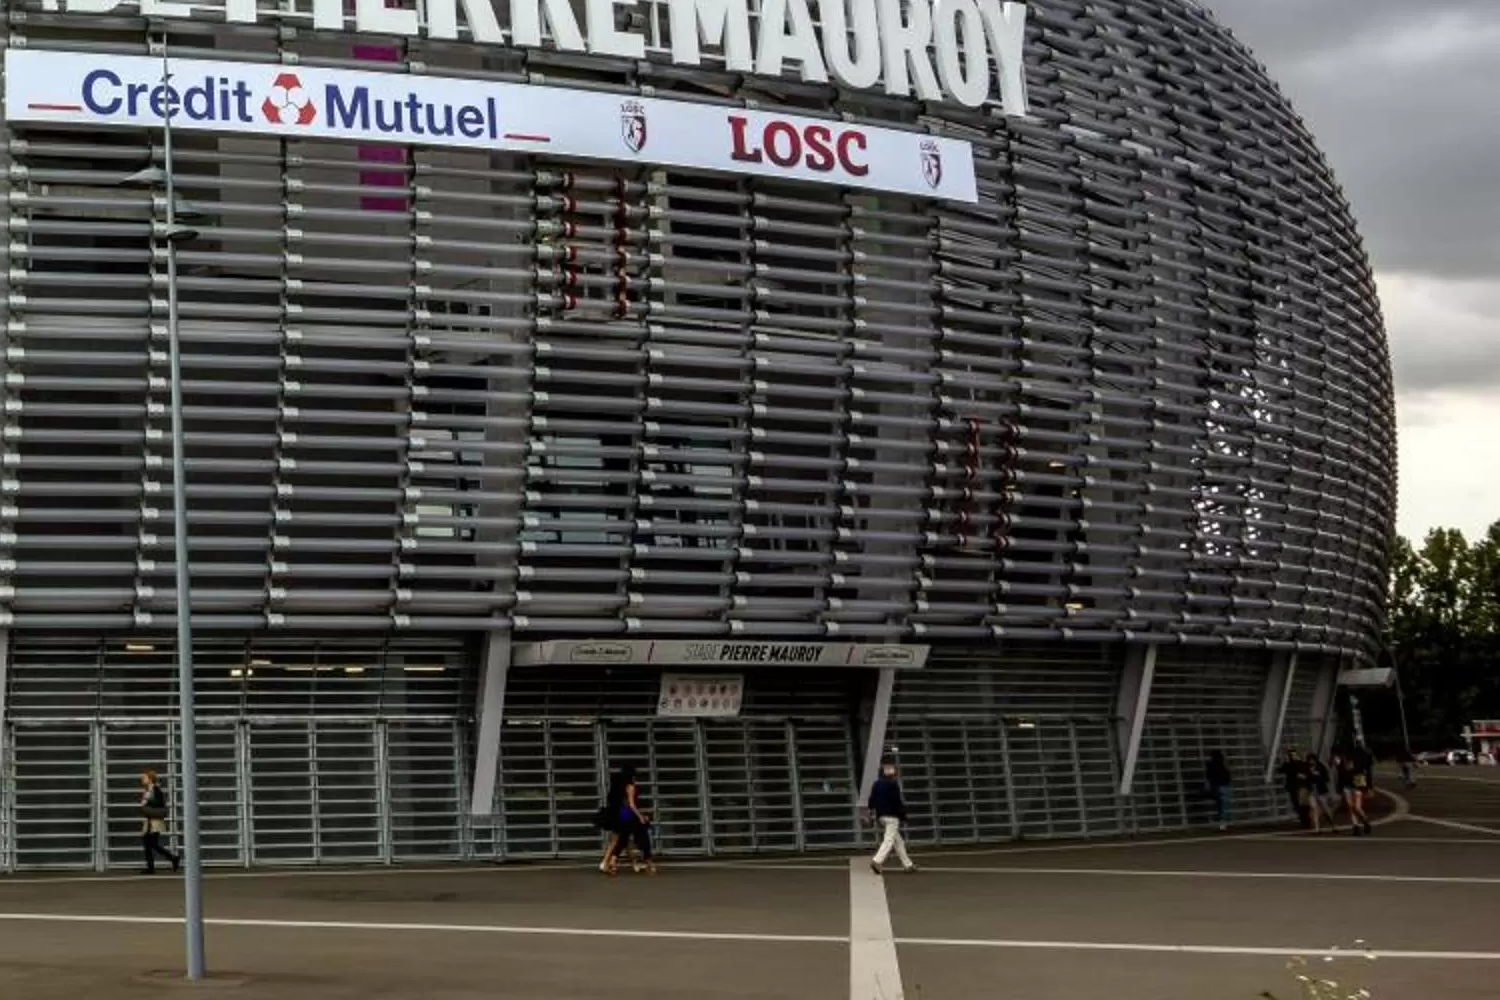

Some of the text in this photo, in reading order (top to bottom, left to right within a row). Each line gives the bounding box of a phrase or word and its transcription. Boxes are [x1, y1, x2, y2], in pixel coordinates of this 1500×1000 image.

[81, 69, 498, 139] Crédit Mutuel
[728, 115, 870, 177] LOSC
[719, 643, 768, 661] PIERRE
[768, 645, 825, 662] MAUROY
